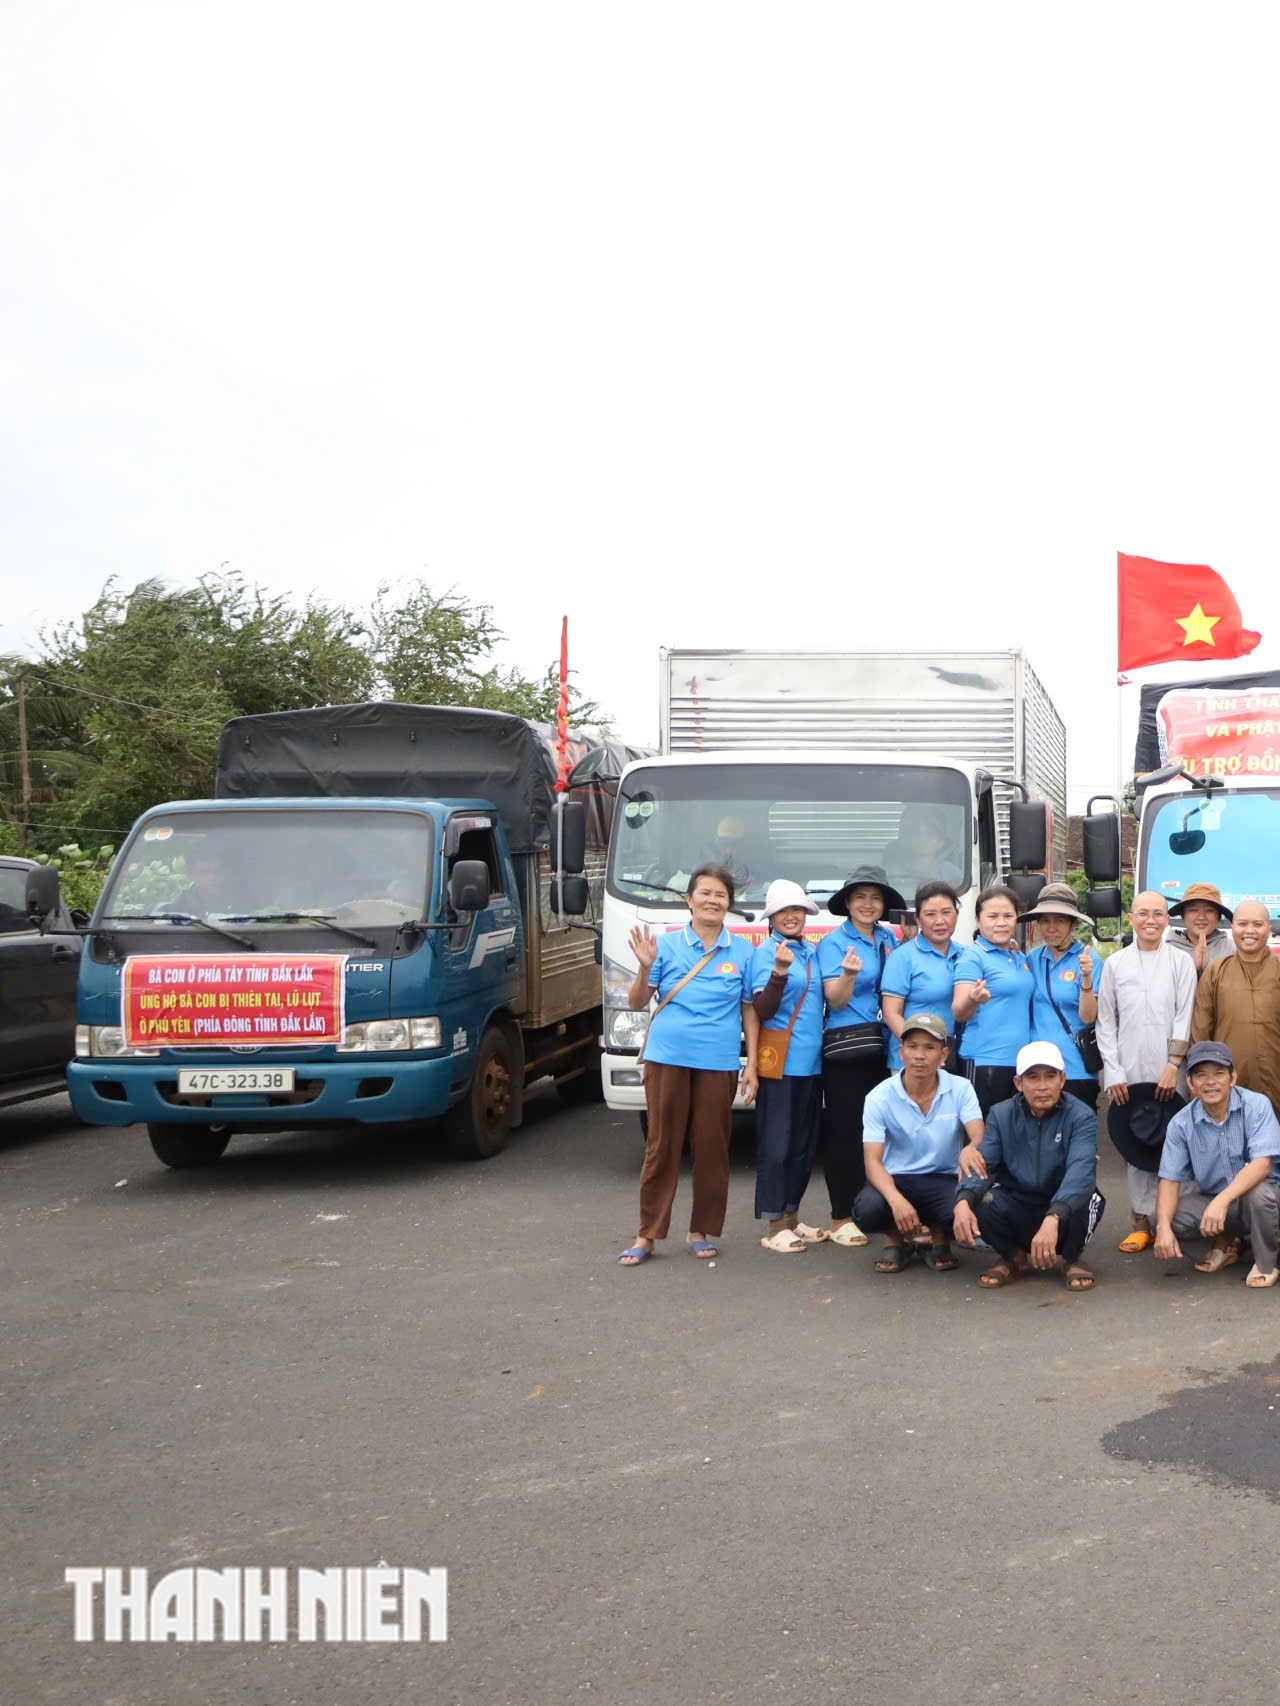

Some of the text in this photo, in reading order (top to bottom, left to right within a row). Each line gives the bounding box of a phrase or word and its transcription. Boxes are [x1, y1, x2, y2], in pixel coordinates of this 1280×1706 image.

[1205, 721, 1230, 738] VÀ
[1201, 752, 1243, 775] TRỢ
[148, 965, 162, 984] BÀ
[164, 967, 186, 984] CON
[197, 964, 222, 983] PHÍA
[225, 964, 244, 983] TÂY
[245, 963, 269, 982] TỈNH
[271, 962, 293, 982] ĐẮK
[294, 962, 314, 982] LẮK
[163, 990, 177, 1012] HỘ
[179, 990, 193, 1008] BÀ
[195, 993, 217, 1008] CON
[219, 993, 230, 1012] BỊ
[232, 989, 262, 1008] THIÊN
[264, 991, 284, 1009] TAI,
[286, 989, 300, 1007] LŨ
[302, 991, 321, 1010] LỤT
[148, 1016, 169, 1034] PHÚ
[171, 1015, 190, 1033] YÊN
[194, 1015, 222, 1037] (PHÍA
[223, 1014, 252, 1033] ĐÔNG
[254, 1013, 278, 1032] TỈNH
[280, 1011, 302, 1032] ĐẮK
[303, 1011, 326, 1035] LẮK)
[189, 1073, 283, 1090] 47C-323.38
